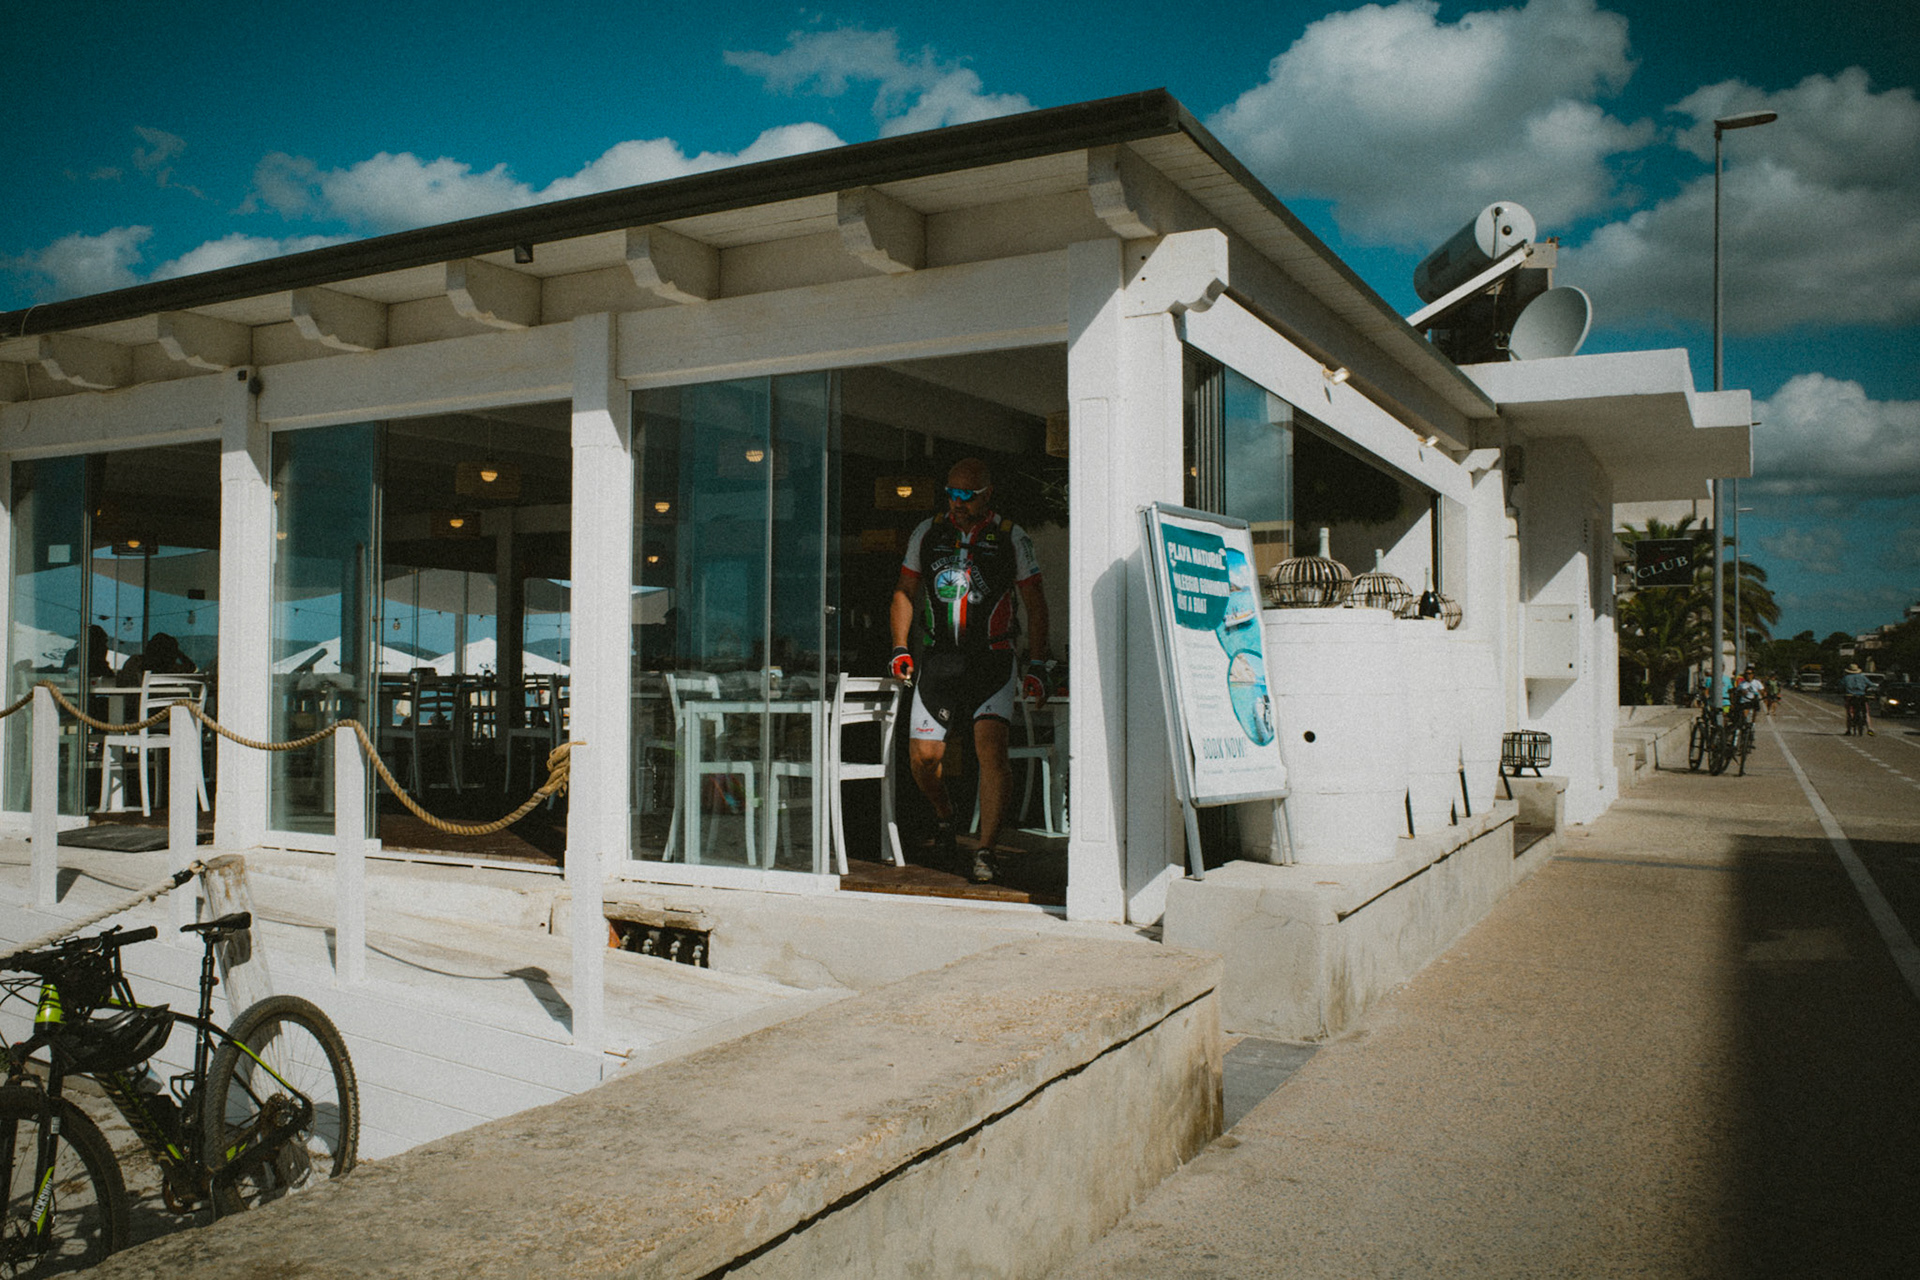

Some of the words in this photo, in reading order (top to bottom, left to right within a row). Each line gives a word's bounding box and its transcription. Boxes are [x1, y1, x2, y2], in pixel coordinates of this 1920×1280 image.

[1167, 541, 1192, 563] PLAYA
[1191, 548, 1226, 570] NATURAL
[1637, 556, 1689, 579] CLUB
[1203, 737, 1225, 759] BOOK
